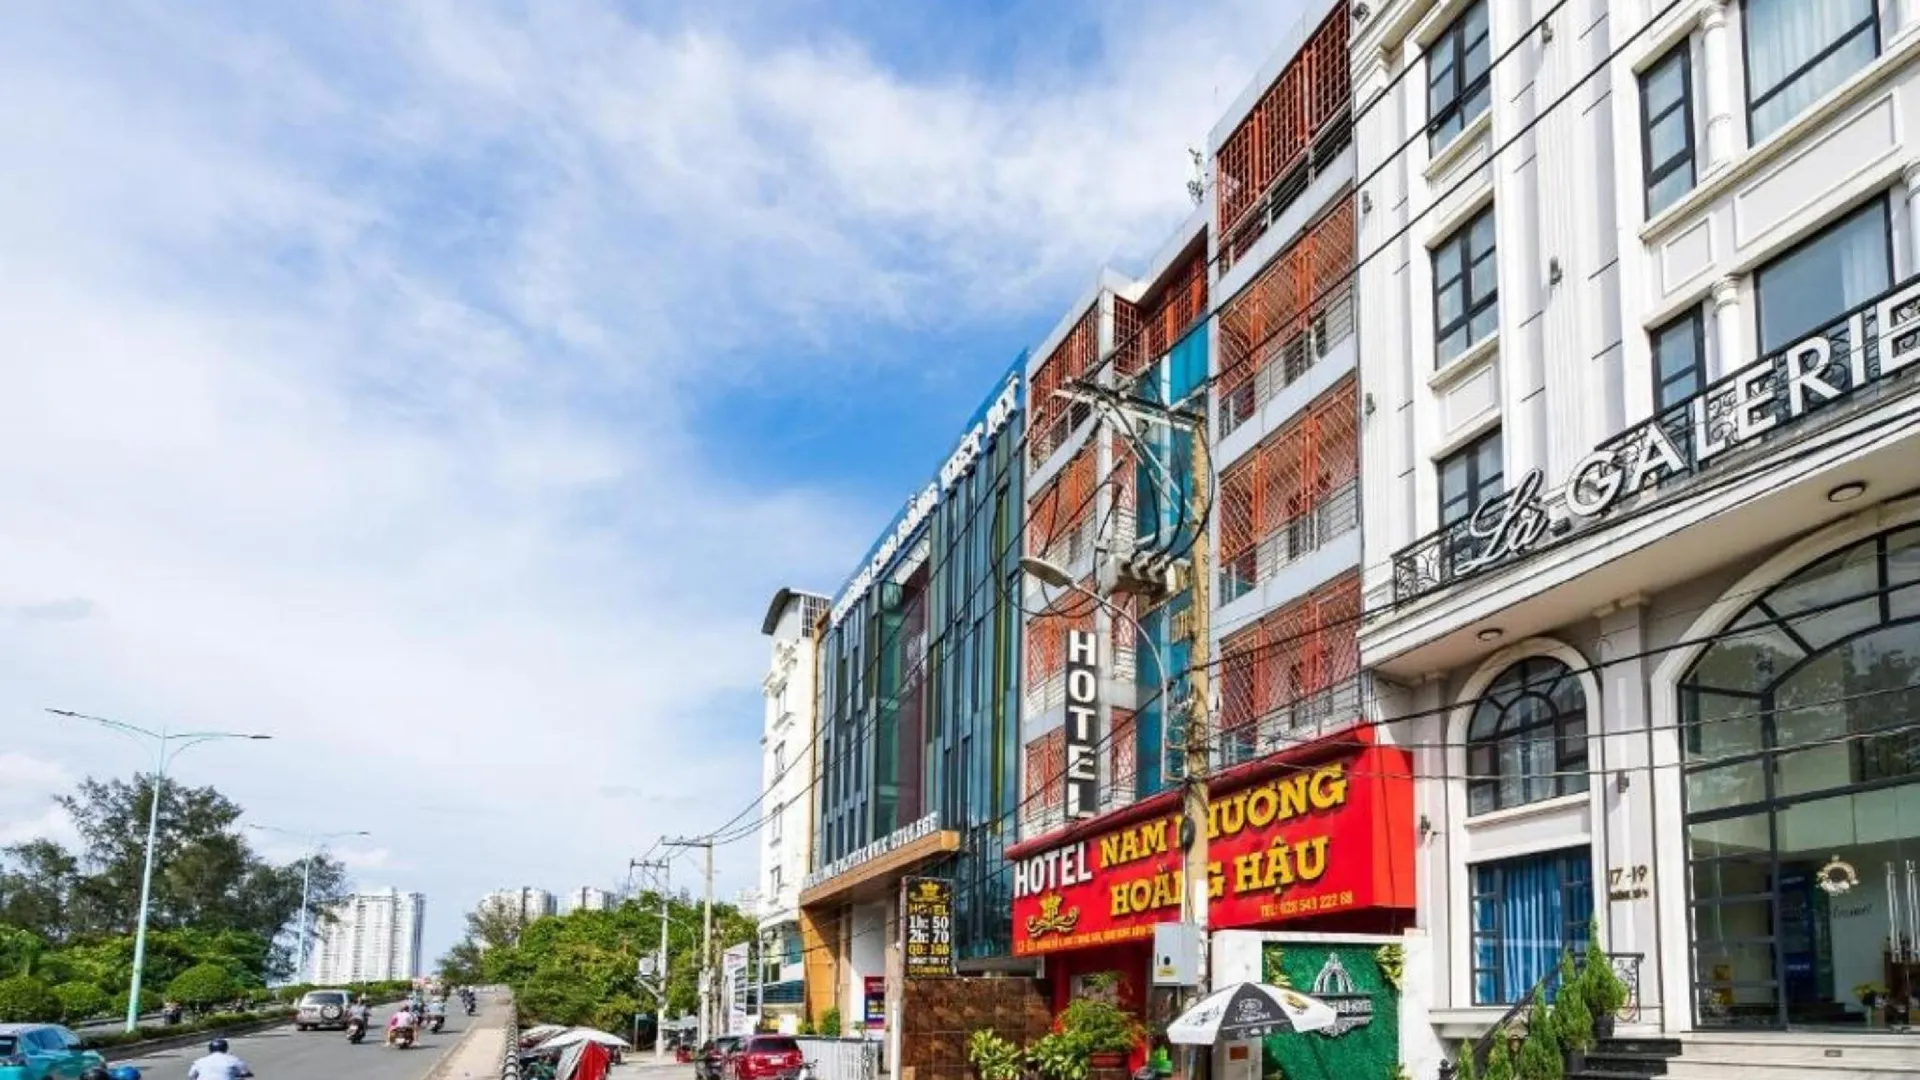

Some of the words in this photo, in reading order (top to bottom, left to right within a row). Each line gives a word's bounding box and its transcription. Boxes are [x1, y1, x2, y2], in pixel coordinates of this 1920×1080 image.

[1566, 282, 1920, 516] GALERIE
[1068, 628, 1097, 818] HOTEL
[1100, 818, 1168, 869] NAM
[1175, 763, 1347, 850] ƯƠNG
[1013, 840, 1093, 899] HOTEL
[1233, 835, 1328, 895] HẬU
[932, 916, 949, 929] 50
[933, 930, 949, 944] 70
